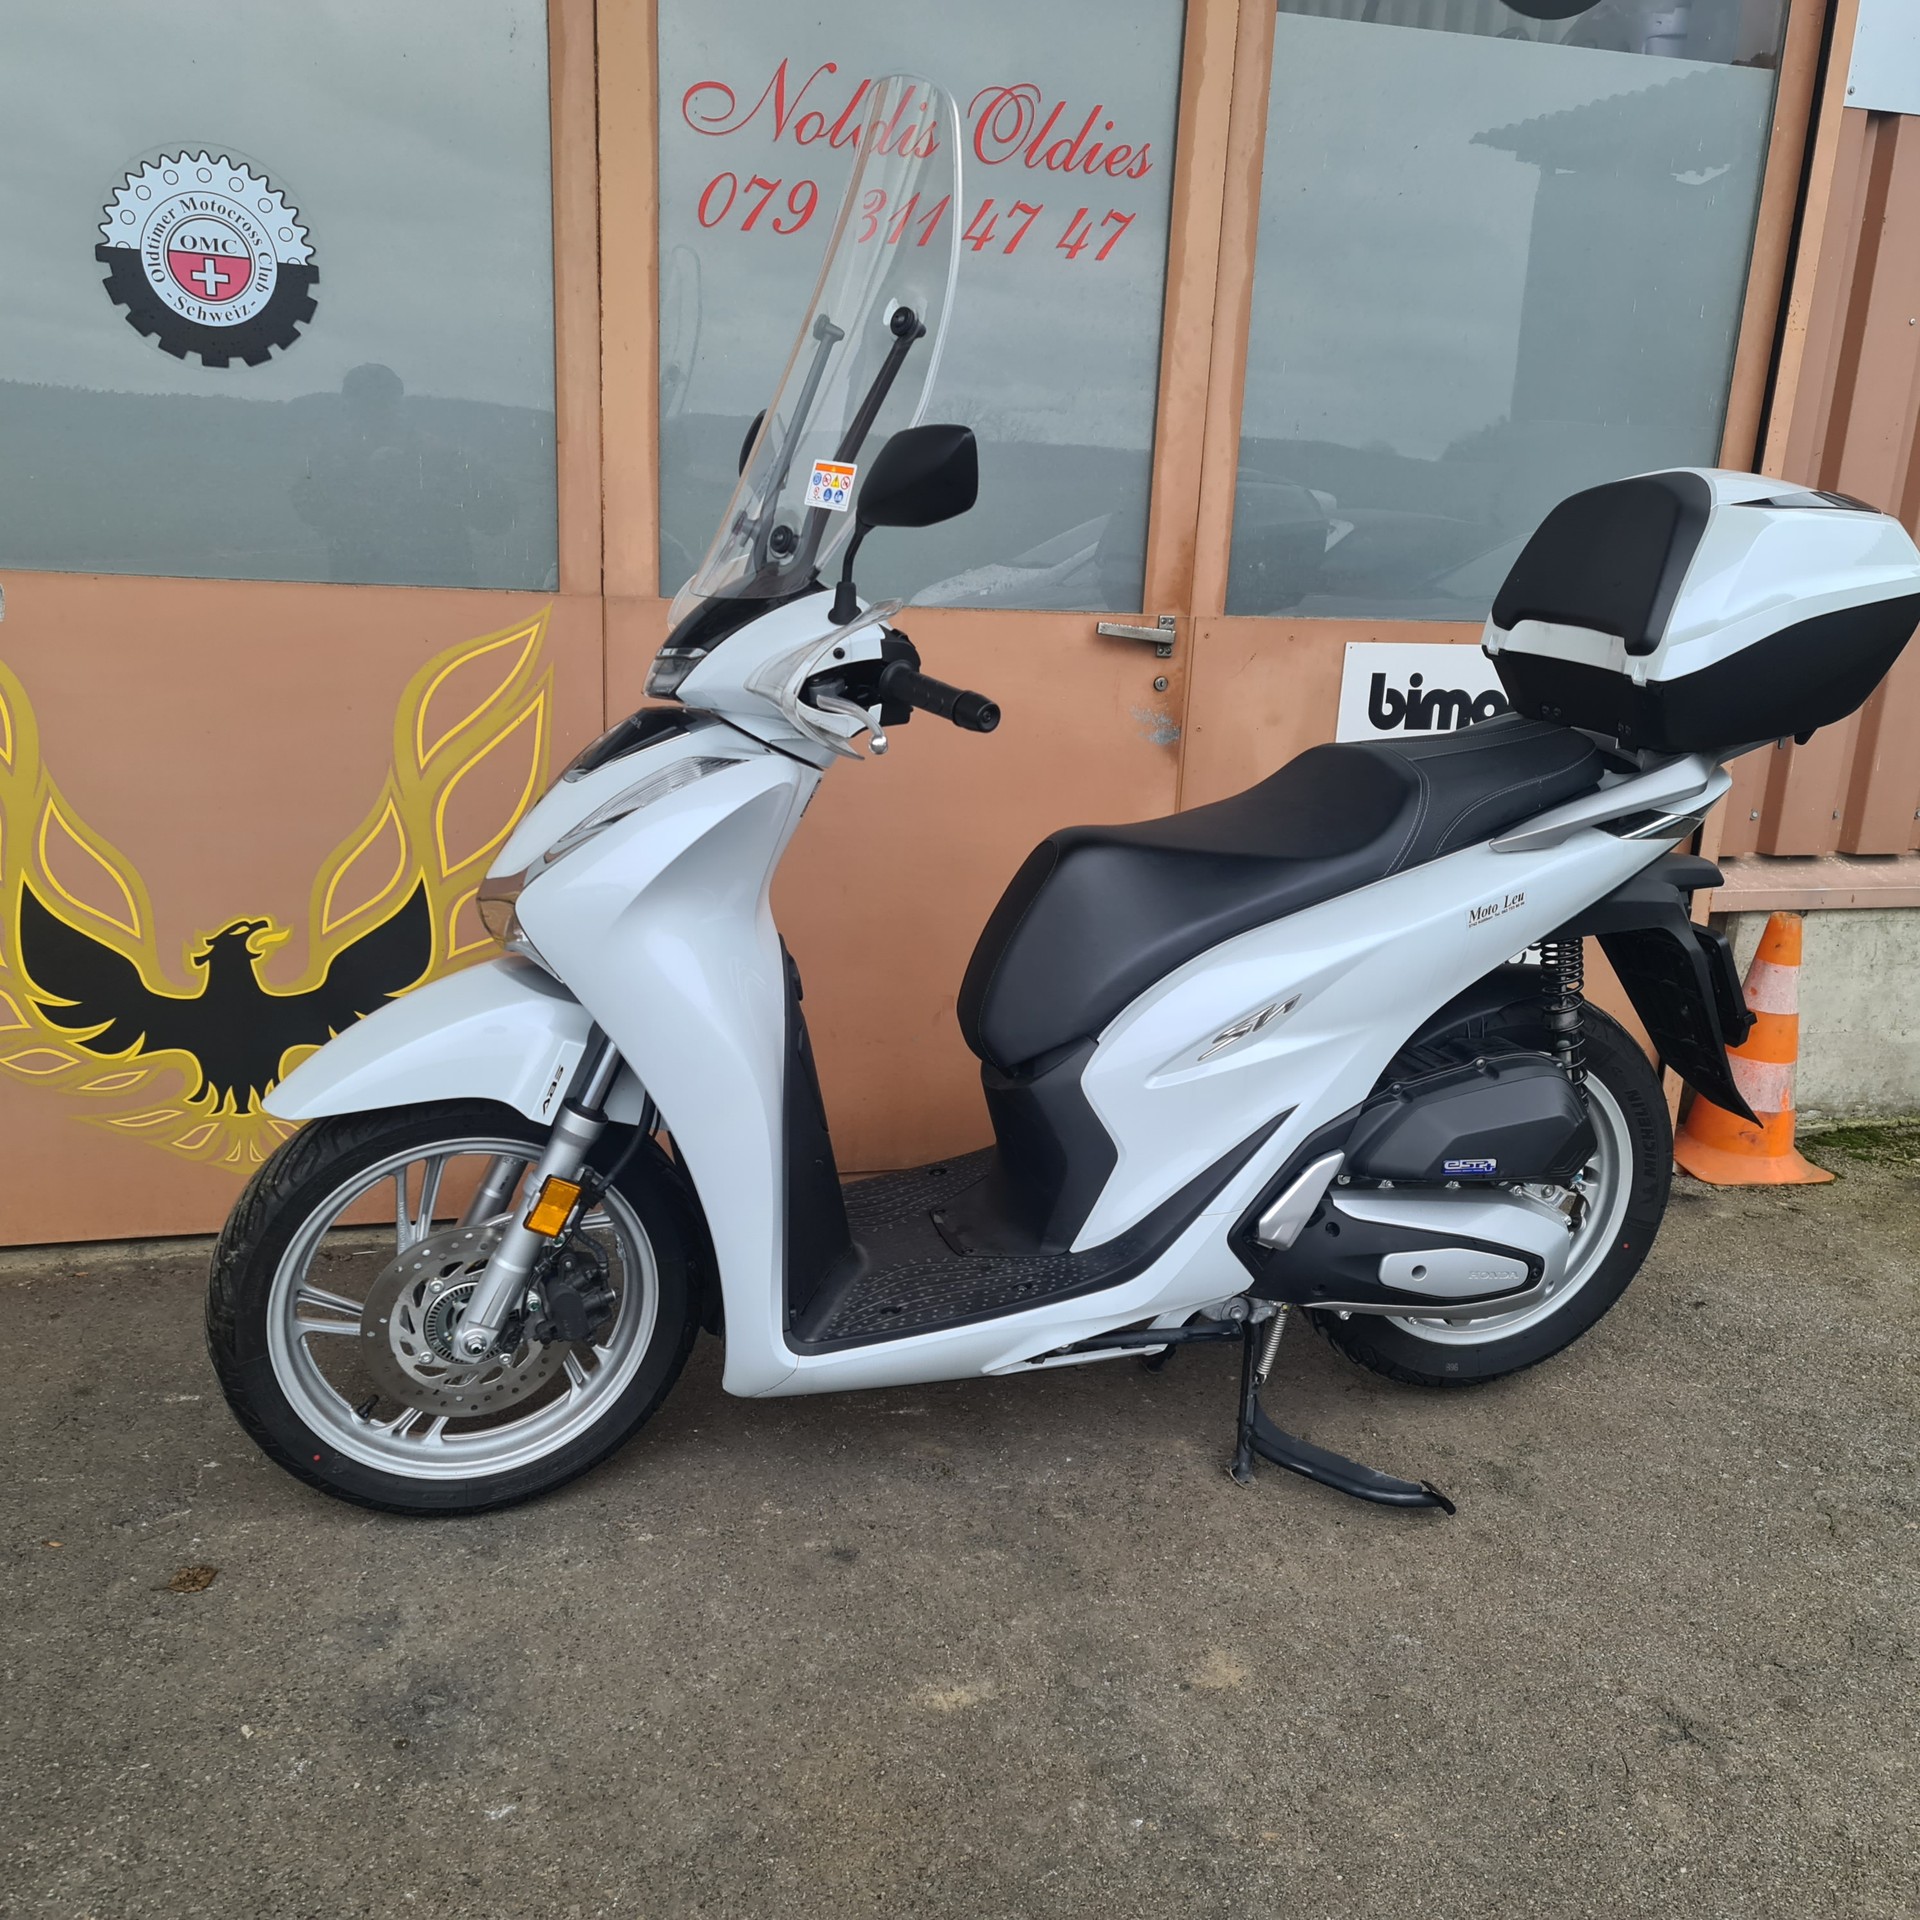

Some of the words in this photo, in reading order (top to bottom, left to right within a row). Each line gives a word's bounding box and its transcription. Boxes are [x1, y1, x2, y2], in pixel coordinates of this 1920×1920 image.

[967, 83, 1153, 178] Oldies
[146, 208, 176, 283] Oldtimer
[179, 197, 263, 246] Motocross
[255, 252, 273, 293] Club
[180, 234, 237, 254] OMC
[698, 171, 818, 235] 079
[858, 188, 951, 247] 311
[962, 198, 1044, 254] 47
[1056, 206, 1136, 261] 47
[173, 295, 250, 322] Schweiz
[1468, 903, 1499, 923] Moto
[1503, 892, 1525, 908] Leu
[1624, 1087, 1657, 1178] MICHELIN
[1468, 1270, 1519, 1280] HONDA
